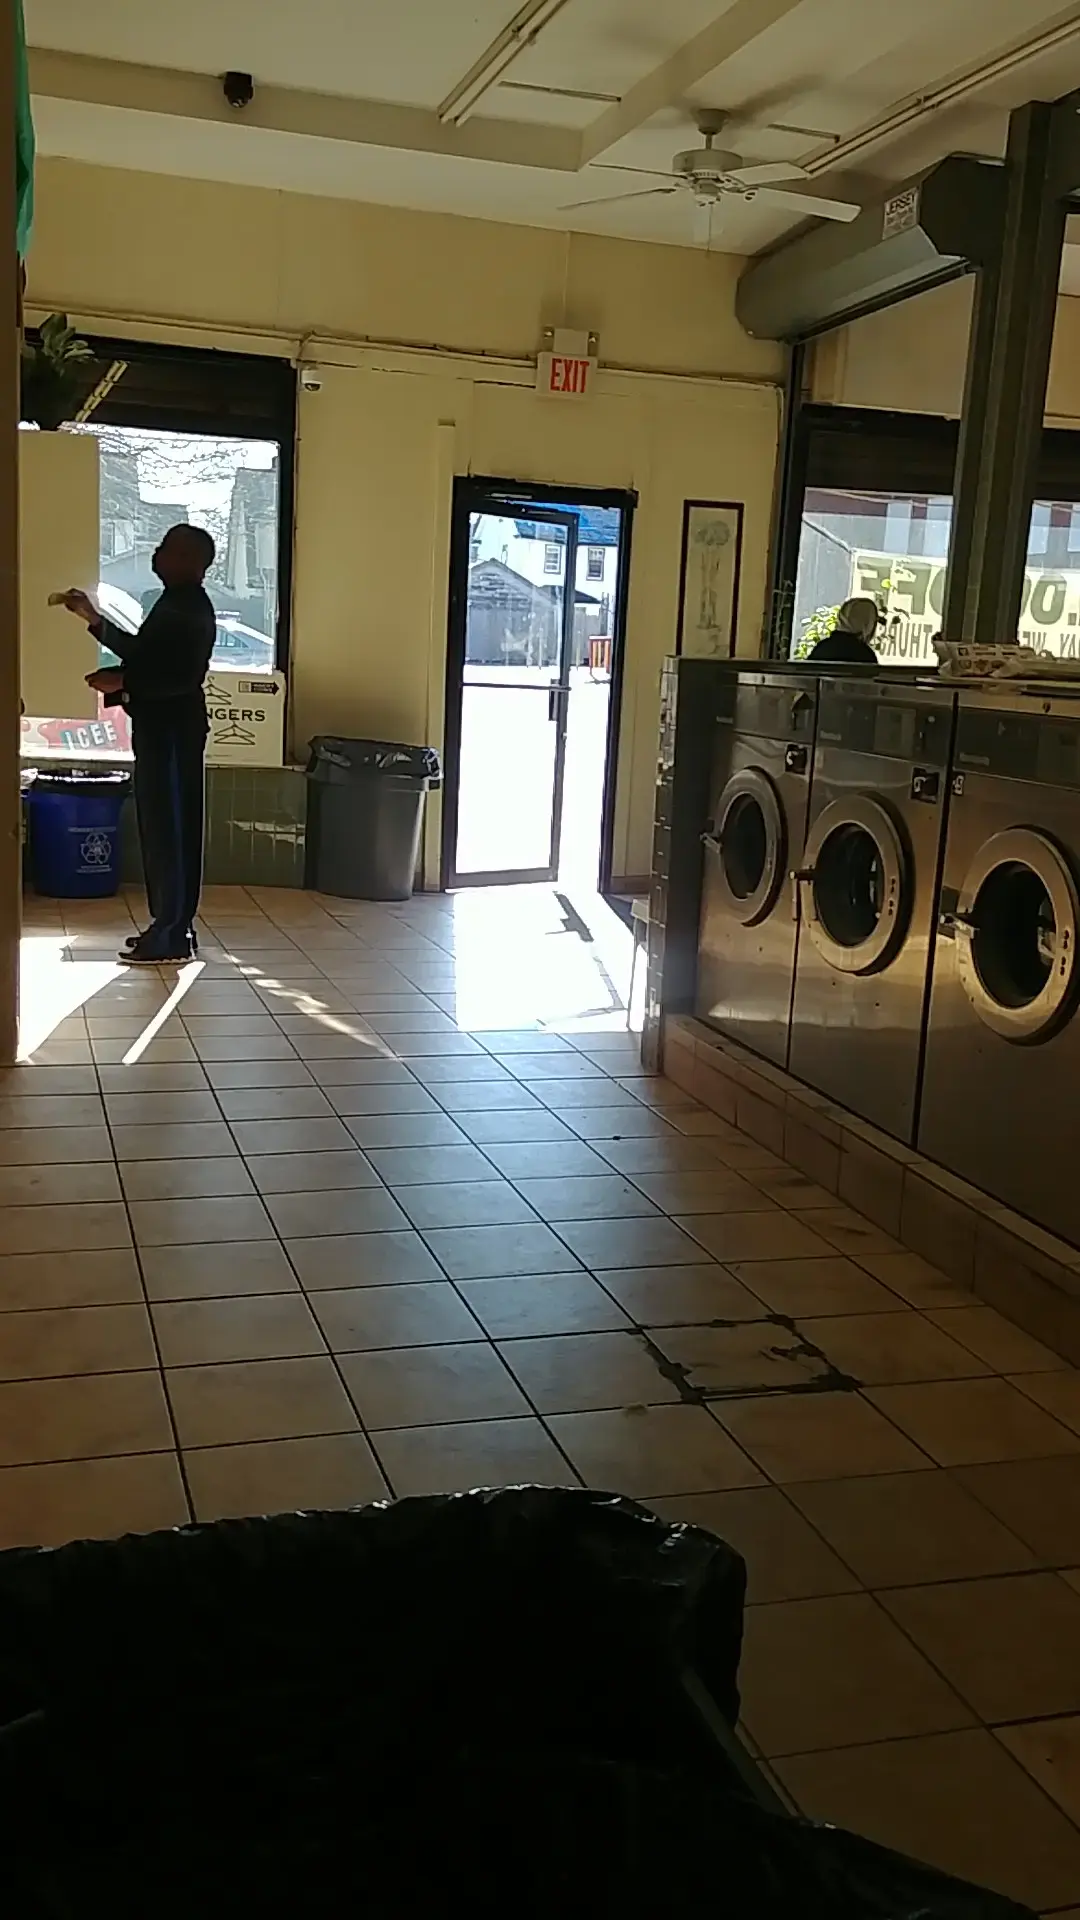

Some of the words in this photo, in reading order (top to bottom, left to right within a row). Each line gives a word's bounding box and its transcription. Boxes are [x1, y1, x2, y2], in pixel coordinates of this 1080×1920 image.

[886, 191, 915, 216] JERSEY
[550, 358, 590, 393] EXIT
[206, 708, 266, 722] NGERS
[63, 721, 117, 750] ICEE
